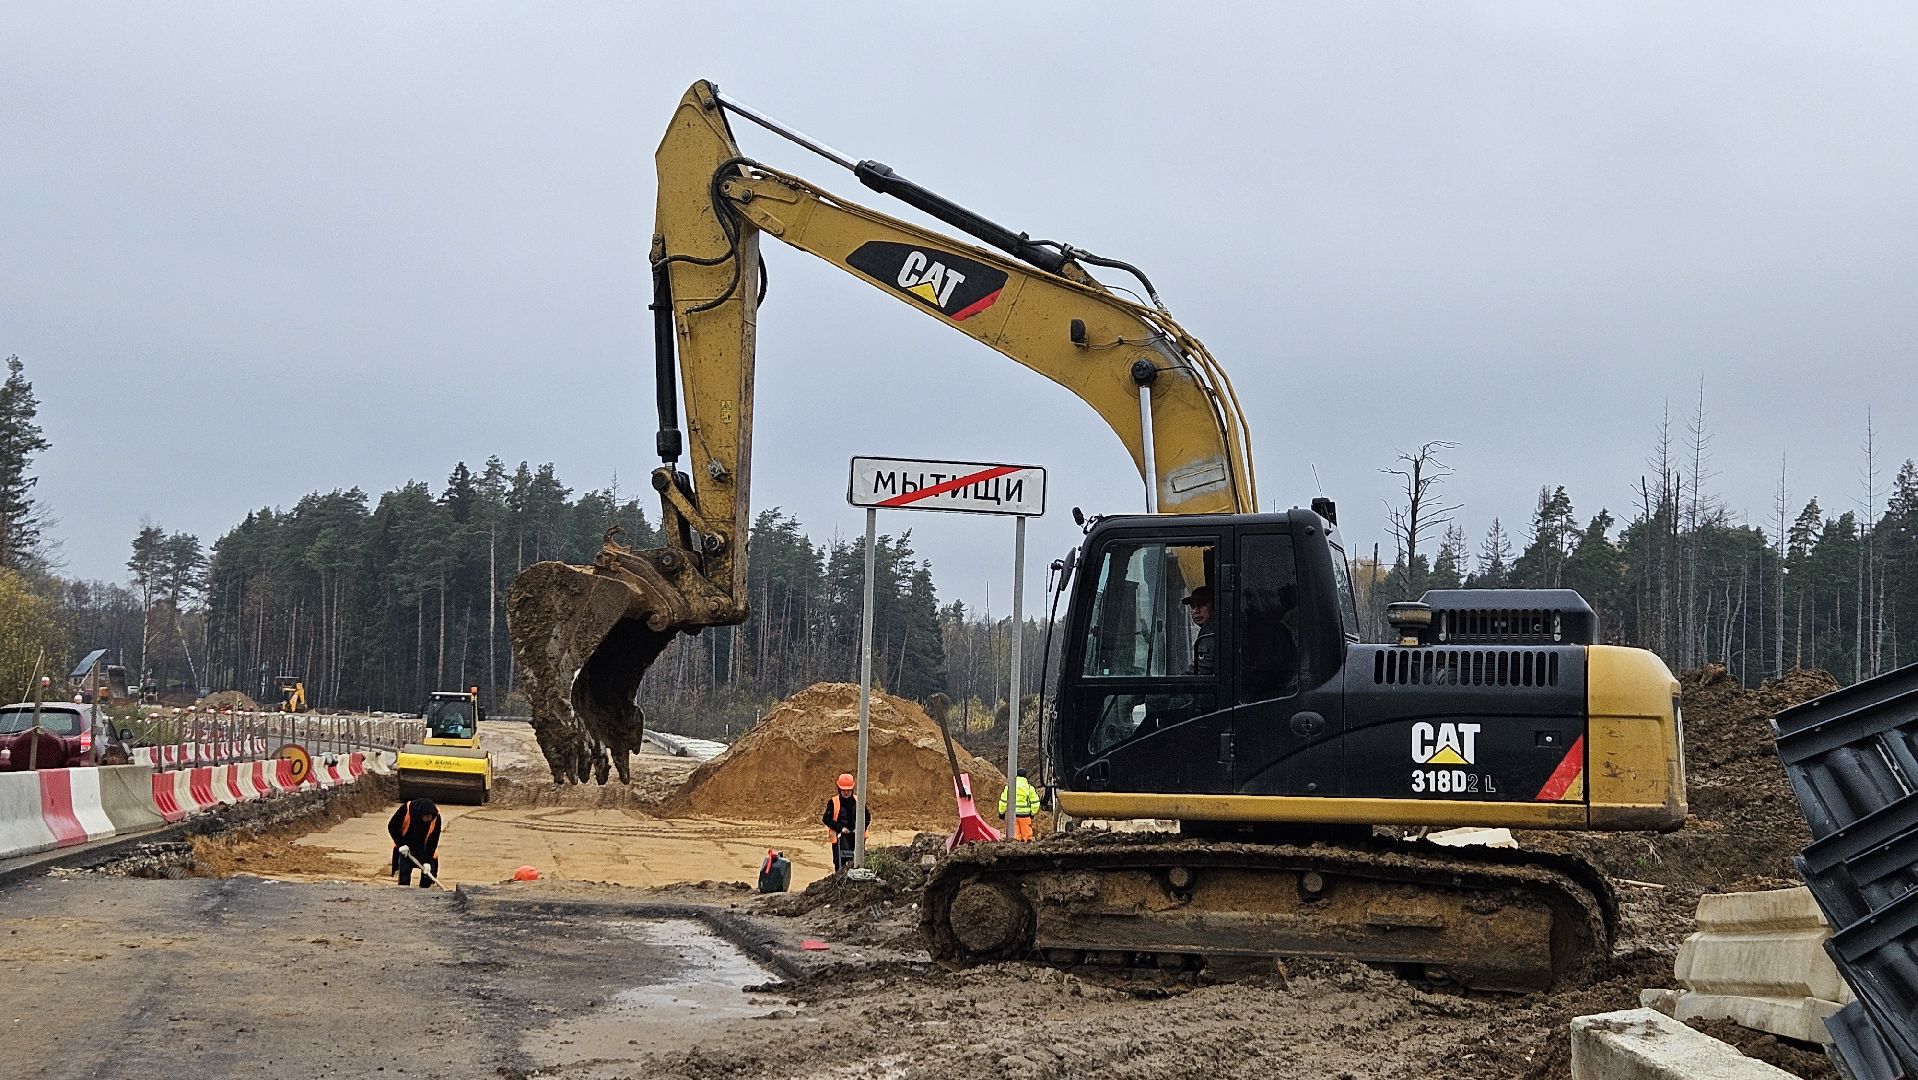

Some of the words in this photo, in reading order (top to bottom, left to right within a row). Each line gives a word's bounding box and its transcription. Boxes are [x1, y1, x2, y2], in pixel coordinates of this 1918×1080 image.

[897, 250, 965, 308] CAT
[873, 470, 1024, 505] МЫТИЩИ
[1411, 721, 1481, 764] CAT
[1484, 774, 1497, 793] L
